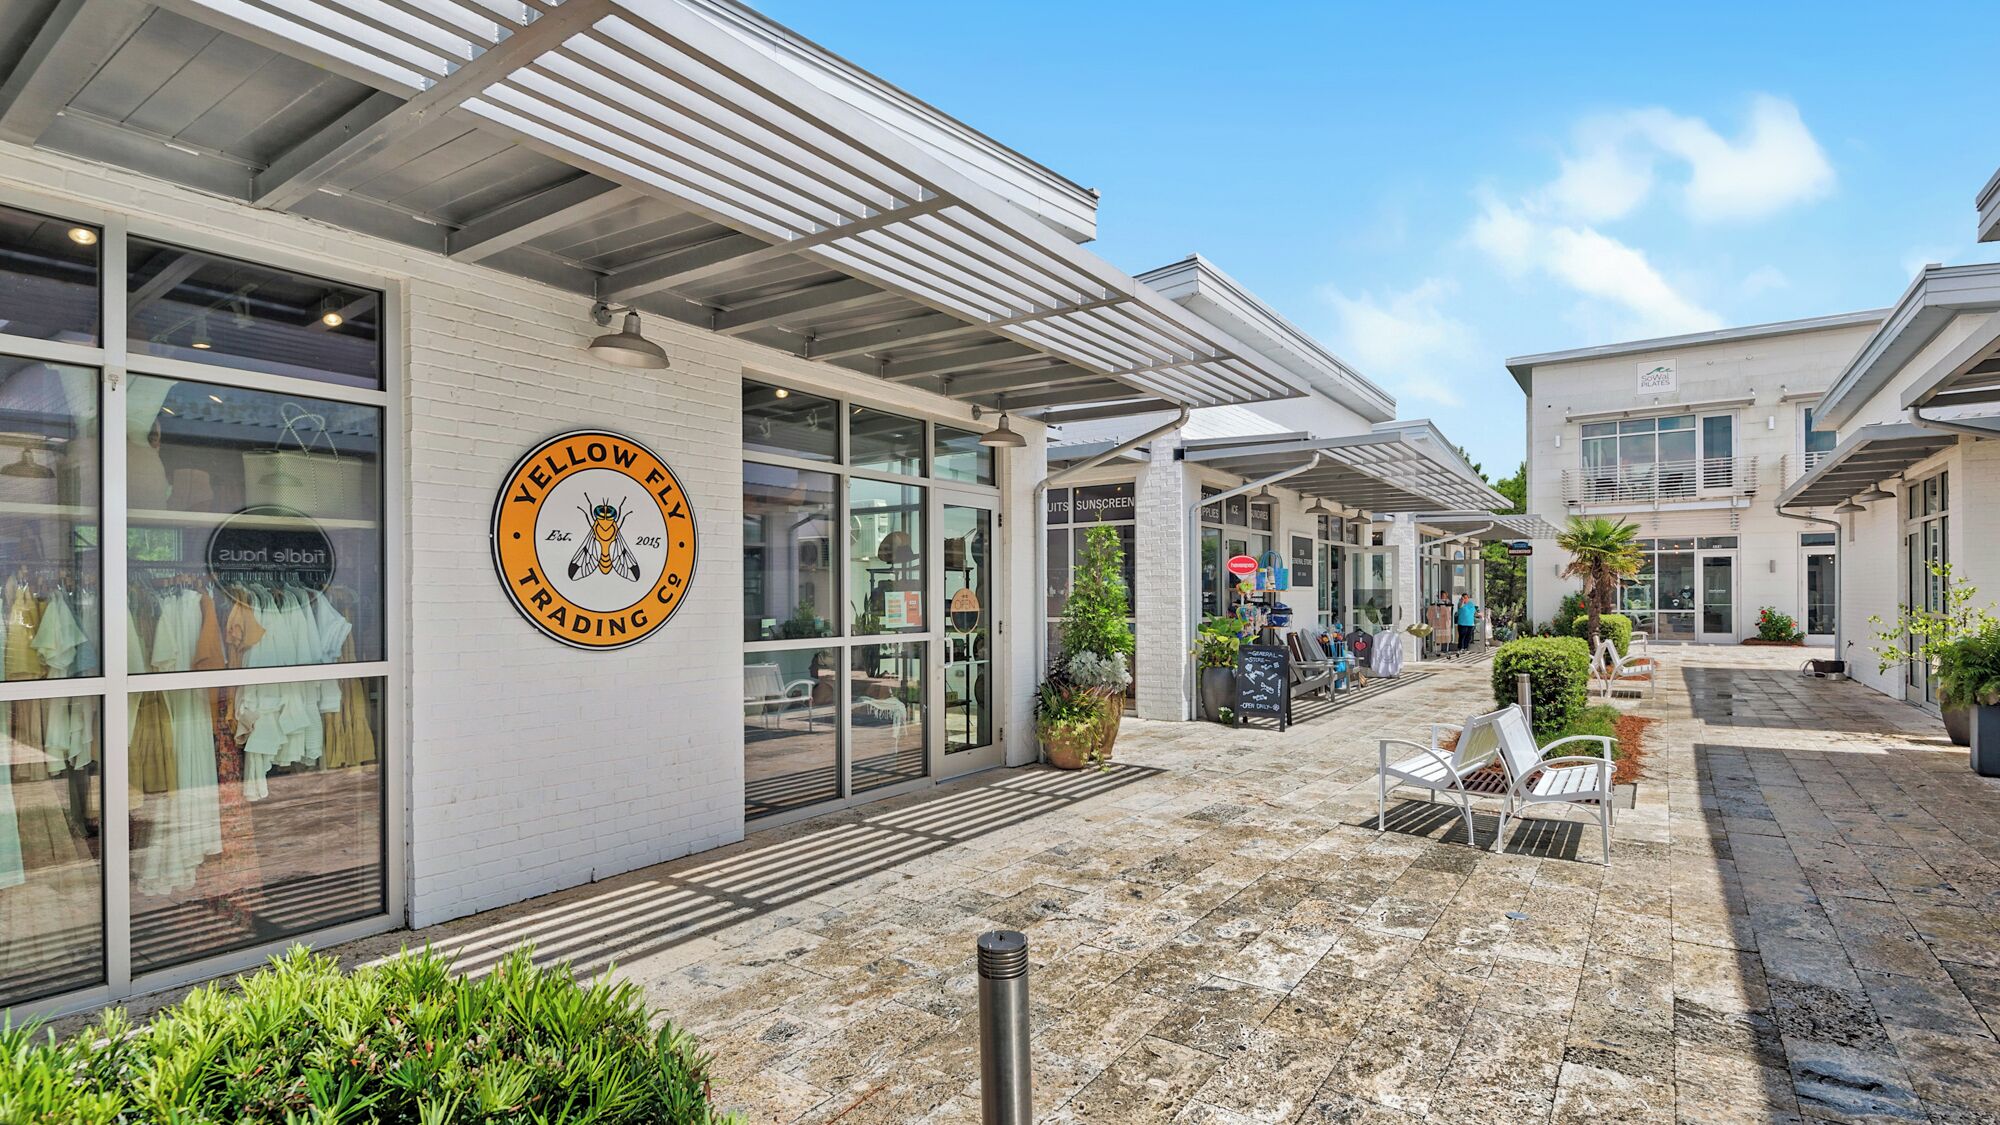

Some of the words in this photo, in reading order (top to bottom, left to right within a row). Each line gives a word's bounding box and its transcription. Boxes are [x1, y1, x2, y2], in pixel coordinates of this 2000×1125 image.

[513, 442, 638, 506] YELLOW
[645, 468, 686, 521] FLY
[1048, 501, 1069, 513] UITS
[1076, 496, 1135, 511] SUNSCREEN
[545, 529, 573, 542] Est.
[635, 536, 661, 549] 2015
[519, 567, 649, 637] TRADING
[954, 599, 976, 610] OPEN
